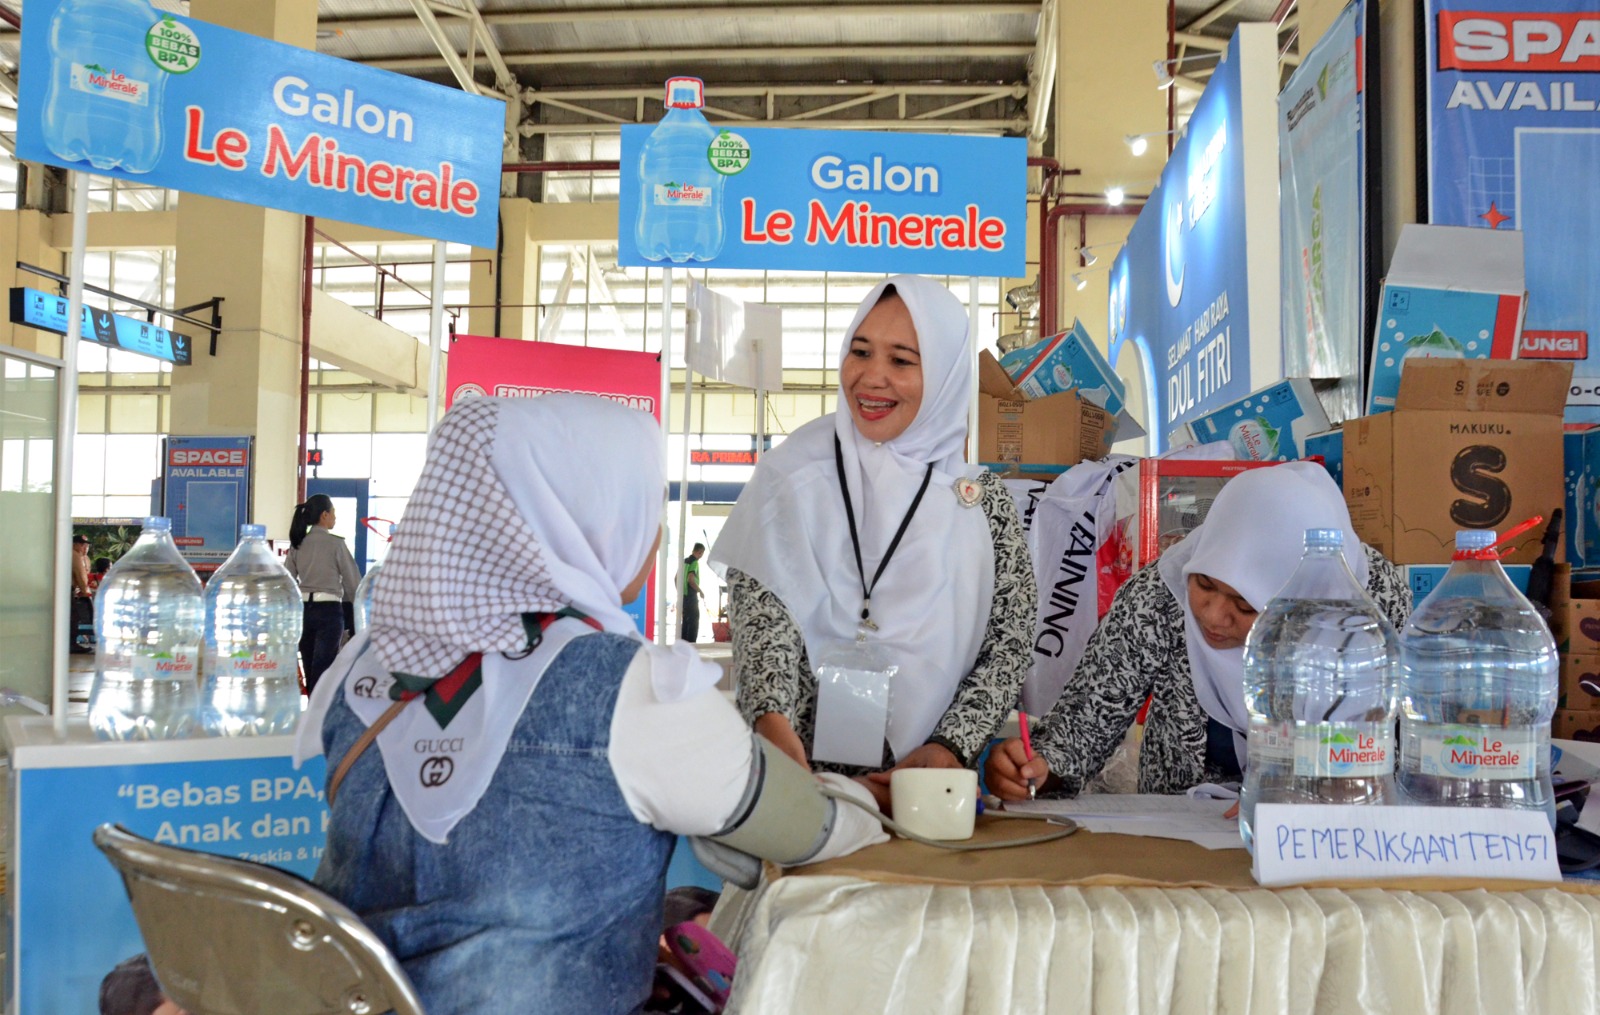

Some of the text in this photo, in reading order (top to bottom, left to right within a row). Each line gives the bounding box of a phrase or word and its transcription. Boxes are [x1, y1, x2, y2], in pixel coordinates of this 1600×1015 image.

[160, 27, 192, 43] 100%
[151, 37, 199, 57] BEBAS
[157, 50, 189, 68] BPA
[88, 73, 138, 95] Minerale
[111, 69, 126, 82] Le
[1446, 80, 1600, 111] AVAIL
[272, 74, 414, 143] Galon
[184, 104, 480, 218] Le Minerale
[712, 149, 748, 157] BEBAS
[717, 159, 742, 168] BPA
[811, 155, 940, 194] Galon
[667, 190, 704, 199] Minerale
[683, 182, 694, 191] Le
[741, 198, 1006, 250] Le Minerale
[1167, 289, 1230, 371] SELAMAT HARI RAYA
[1520, 337, 1579, 351] UNGI
[1167, 325, 1232, 424] IDUL FITRI
[1251, 433, 1262, 446] Le
[173, 451, 243, 464] SPACE
[711, 451, 753, 463] PRIMA
[170, 468, 245, 478] AVAILABLE
[1450, 444, 1512, 529] S
[175, 652, 187, 662] Le
[252, 651, 267, 661] Le
[233, 660, 279, 671] Minerale
[413, 737, 465, 754] GUCCI
[1359, 732, 1375, 749] Le
[1482, 736, 1503, 753] Le
[1329, 747, 1386, 764] Minerale
[1450, 749, 1520, 765] Minerale
[251, 776, 324, 802] BPA,
[154, 816, 242, 845] Anak
[251, 813, 310, 839] dan
[296, 847, 308, 860] &
